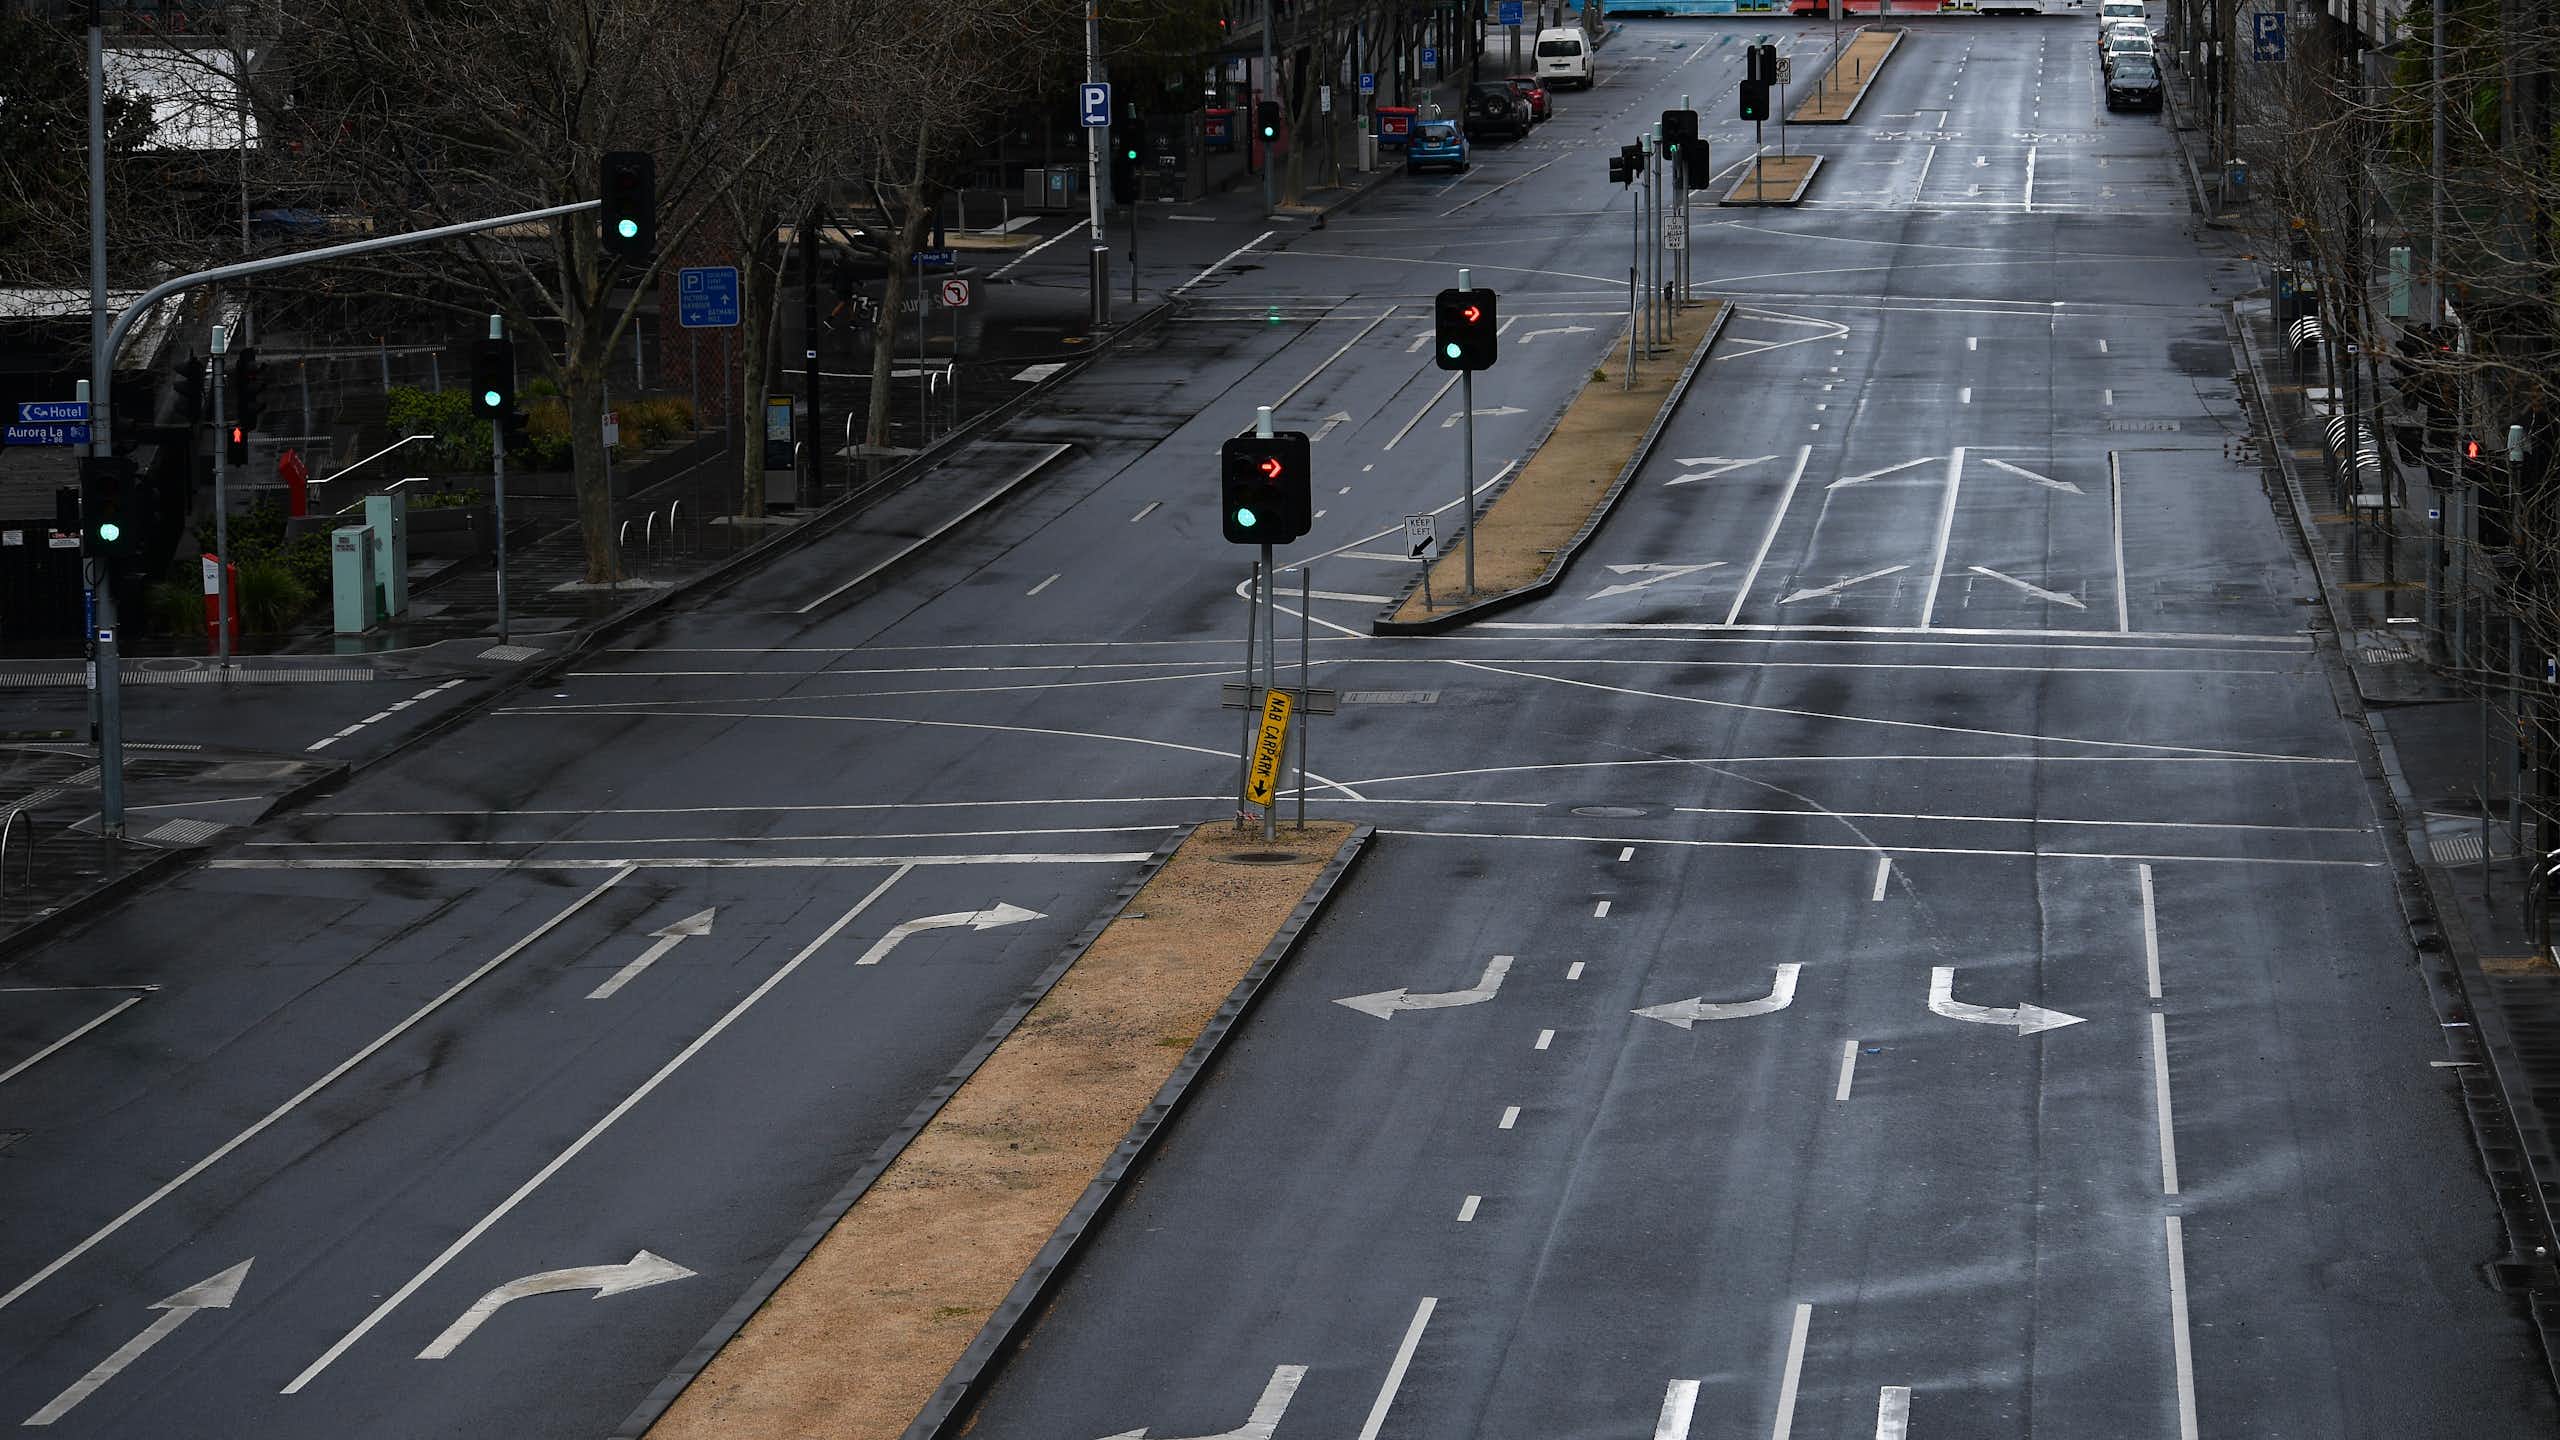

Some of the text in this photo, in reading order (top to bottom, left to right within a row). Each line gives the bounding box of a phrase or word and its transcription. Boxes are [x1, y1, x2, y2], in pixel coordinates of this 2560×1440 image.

[2260, 15, 2277, 39] P
[1425, 51, 1433, 60] P
[1362, 76, 1370, 87] P
[1085, 88, 1105, 113] P
[687, 275, 699, 289] P
[50, 406, 82, 417] Hotel
[8, 426, 63, 438] Aurora La
[1410, 519, 1430, 527] KEEP
[1412, 528, 1430, 536] LEFT
[1257, 697, 1285, 777] NAB CARPARK
